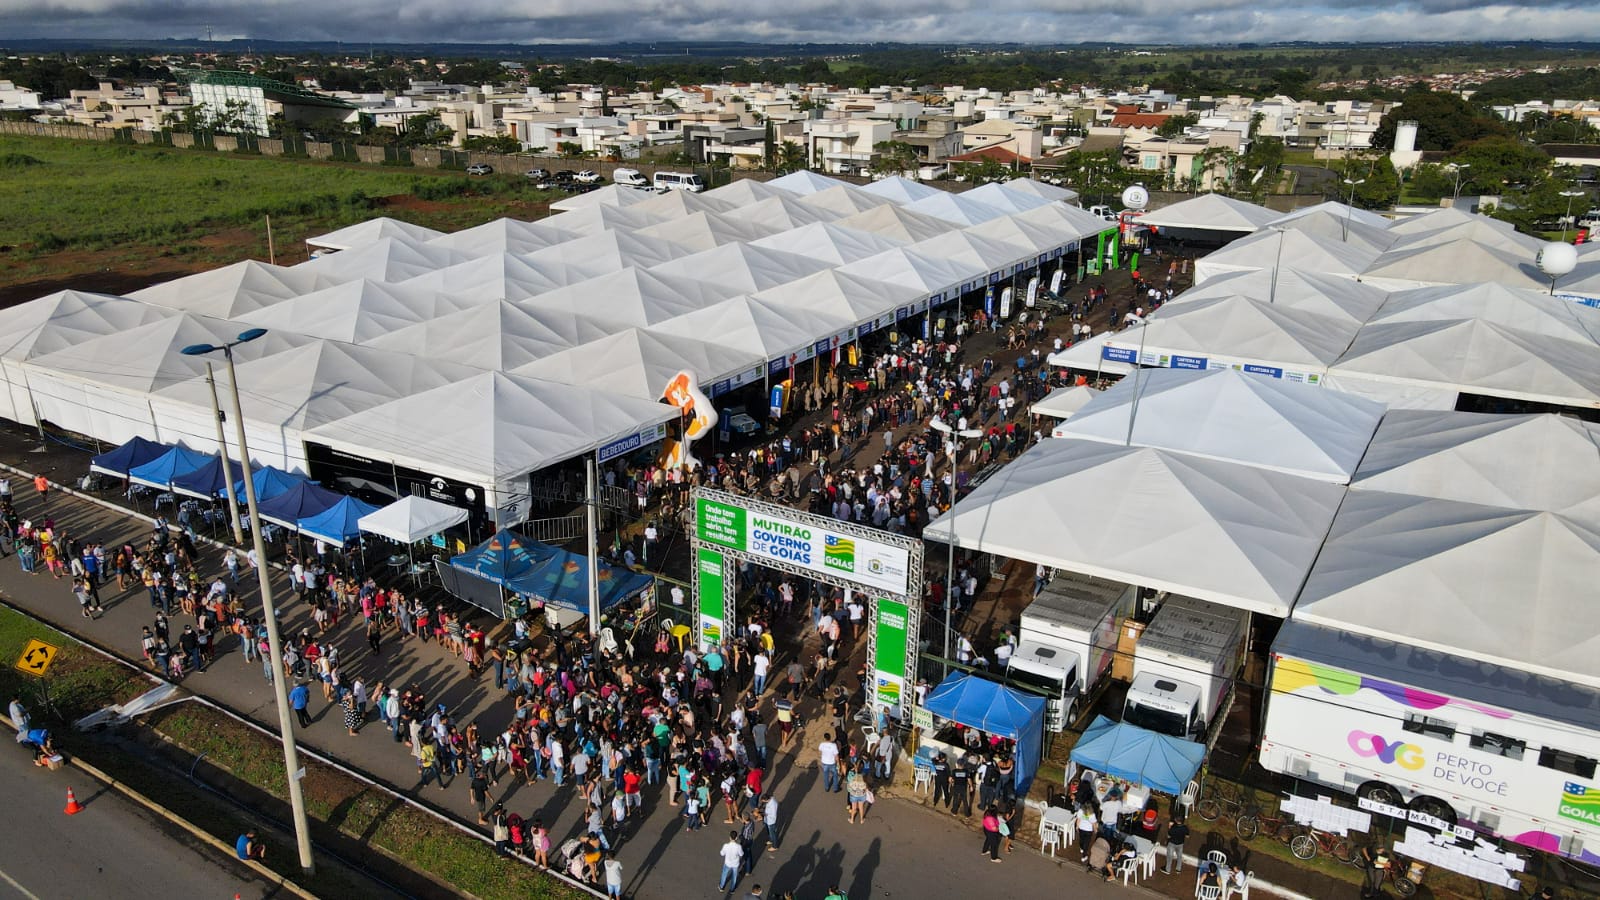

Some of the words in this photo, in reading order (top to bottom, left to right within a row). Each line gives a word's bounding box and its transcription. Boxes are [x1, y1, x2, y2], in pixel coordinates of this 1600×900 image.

[601, 436, 639, 458] BEBEDOURO
[705, 504, 721, 515] Onde
[722, 509, 736, 518] tem
[705, 513, 732, 526] trabalho
[724, 526, 737, 536] tem
[753, 517, 812, 540] MUTIRÃO
[753, 529, 811, 552] GOVERNO
[753, 541, 767, 552] DE
[769, 545, 811, 564] GOIÁS
[1436, 752, 1492, 776] PERTO
[1433, 766, 1456, 782] DE
[1459, 773, 1509, 796] VOCÊ
[1359, 800, 1406, 817] LISTA
[1455, 827, 1472, 838] DE
